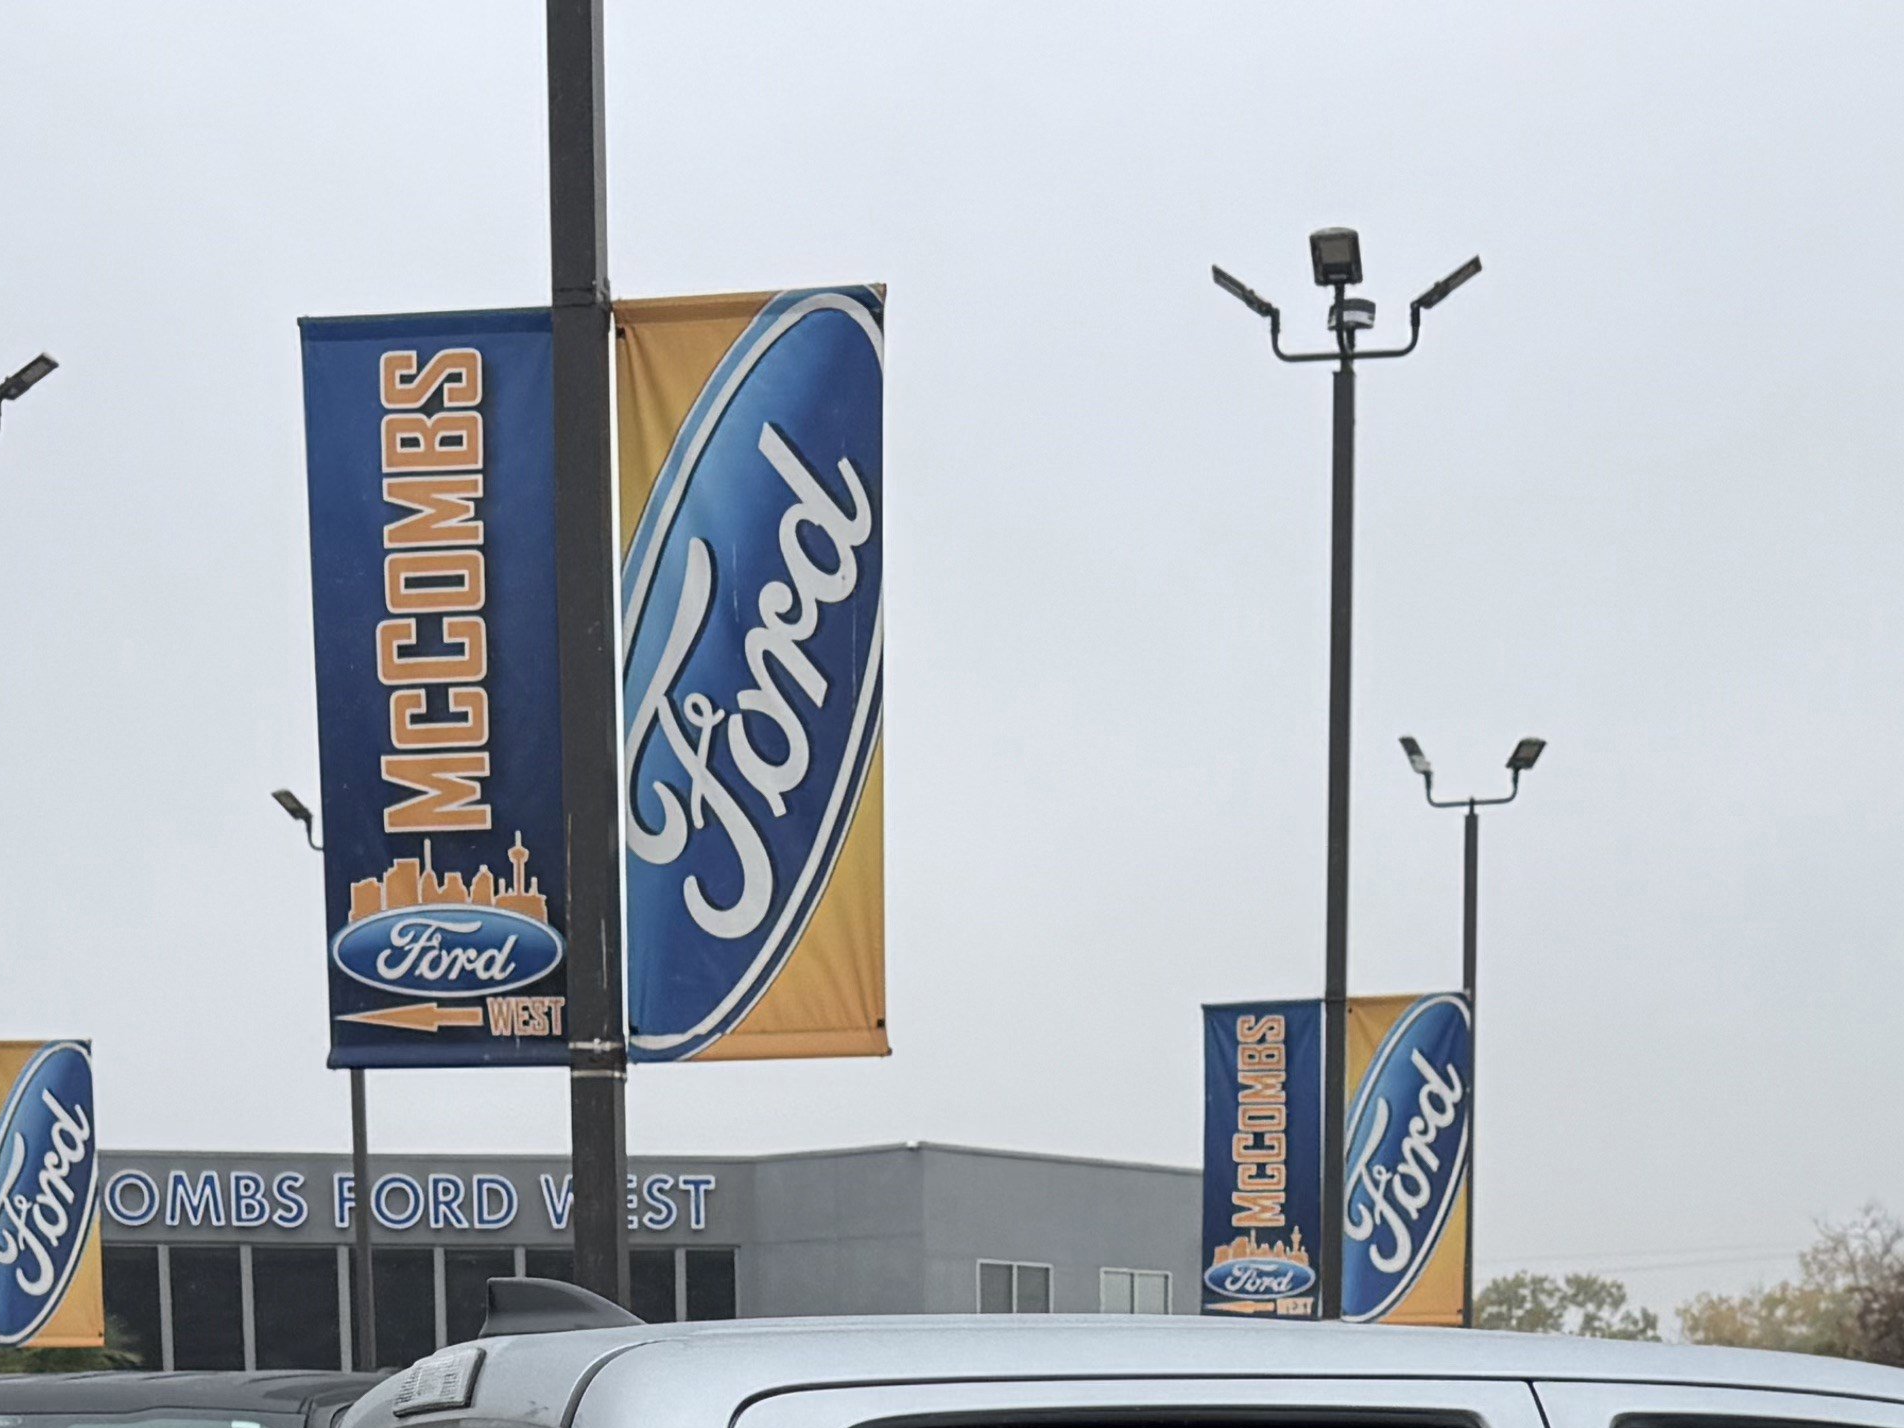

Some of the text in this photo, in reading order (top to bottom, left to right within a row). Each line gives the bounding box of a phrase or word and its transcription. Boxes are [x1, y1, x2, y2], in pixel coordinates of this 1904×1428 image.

[375, 347, 492, 834] MCCOMBS
[627, 422, 873, 940] Ford
[375, 916, 519, 982] Ford
[487, 996, 566, 1038] WEST
[1231, 1014, 1287, 1228] MCCOMBS
[1343, 1048, 1463, 1273] Ford
[104, 1168, 309, 1229] OMBS
[332, 1172, 519, 1230] FORD
[1225, 1261, 1292, 1293] Ford
